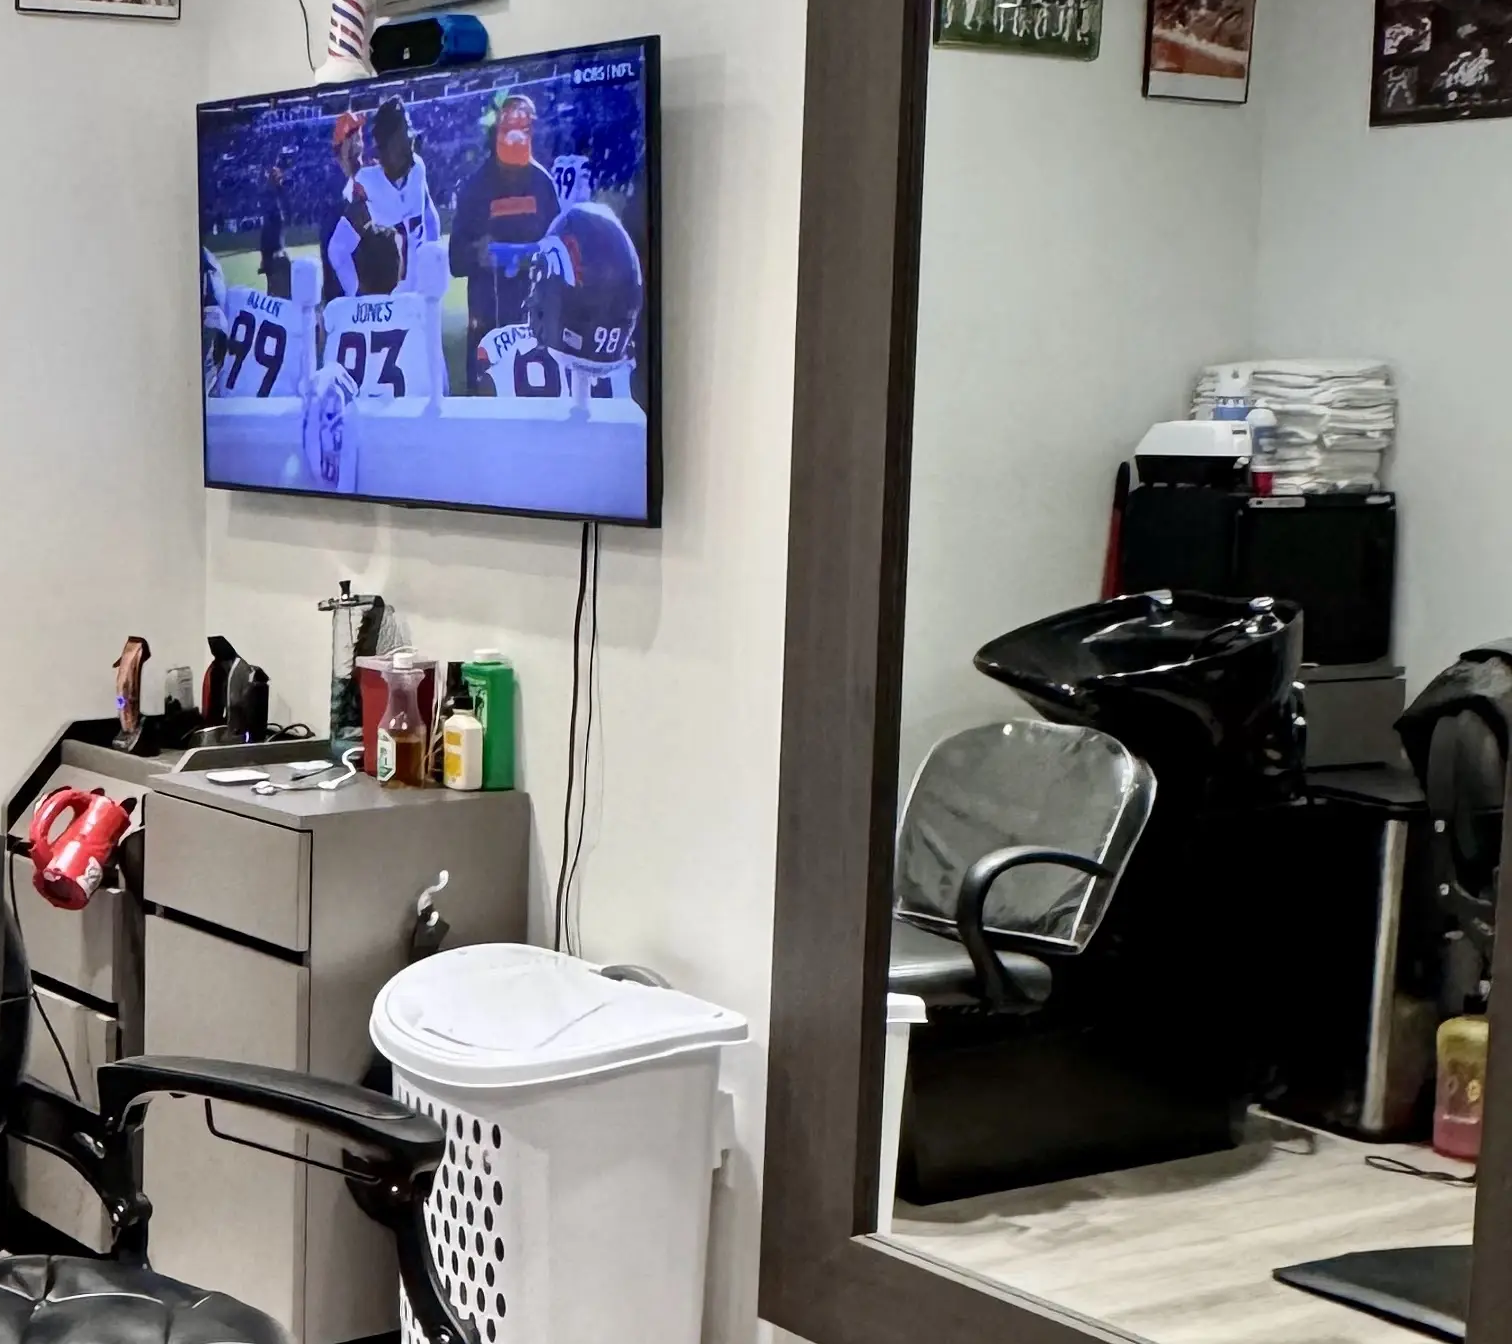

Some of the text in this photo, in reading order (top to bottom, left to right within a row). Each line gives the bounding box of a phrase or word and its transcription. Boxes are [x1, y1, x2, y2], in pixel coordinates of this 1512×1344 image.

[351, 301, 394, 324] JONES
[225, 309, 287, 398] 99
[336, 328, 409, 399] 93
[593, 326, 622, 354] 98
